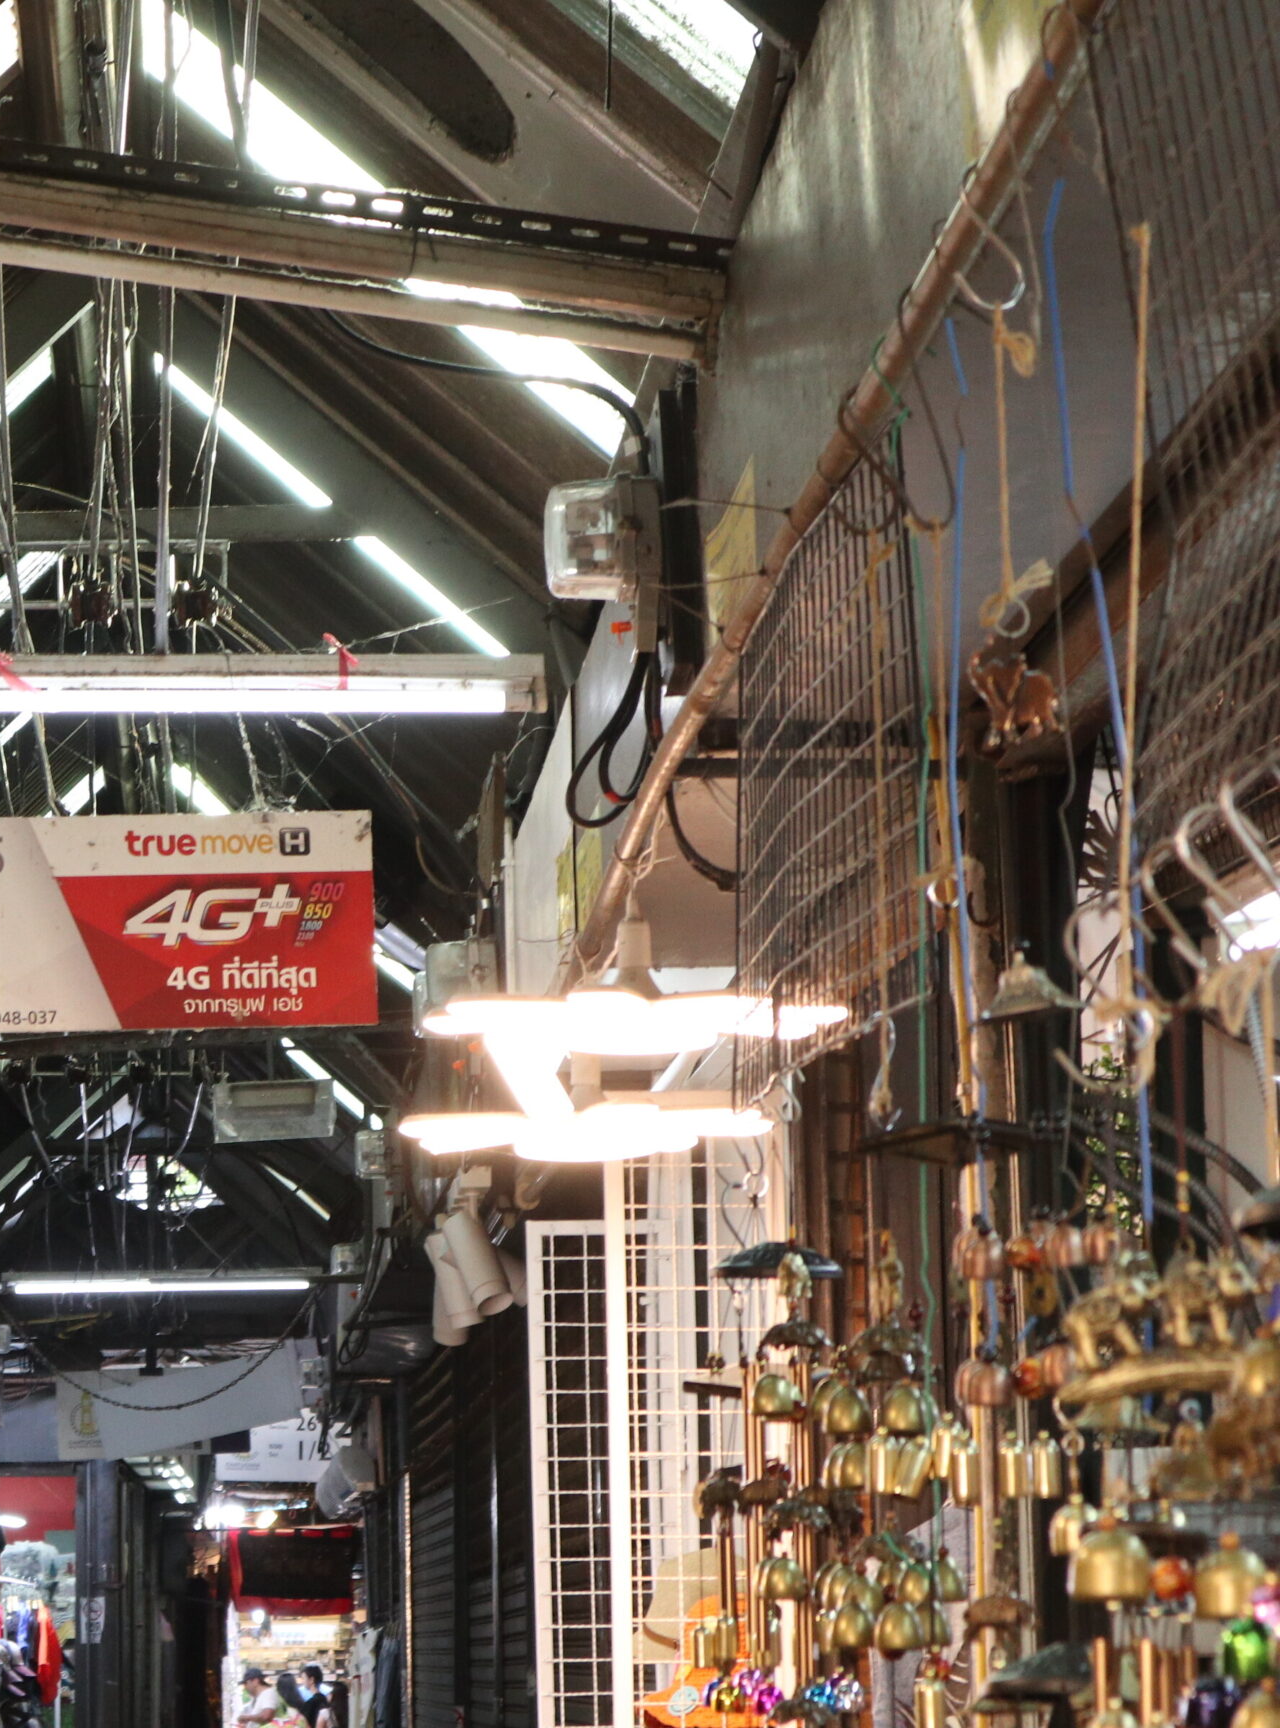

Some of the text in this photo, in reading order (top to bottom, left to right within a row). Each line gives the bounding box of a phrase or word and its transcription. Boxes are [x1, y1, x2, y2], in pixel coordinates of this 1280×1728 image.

[282, 829, 308, 855] H
[309, 882, 345, 902] 900
[303, 903, 333, 919] 850
[167, 955, 318, 995] 4G ที่ดีที่สุด
[273, 996, 304, 1012] เอช
[296, 1416, 318, 1432] 26
